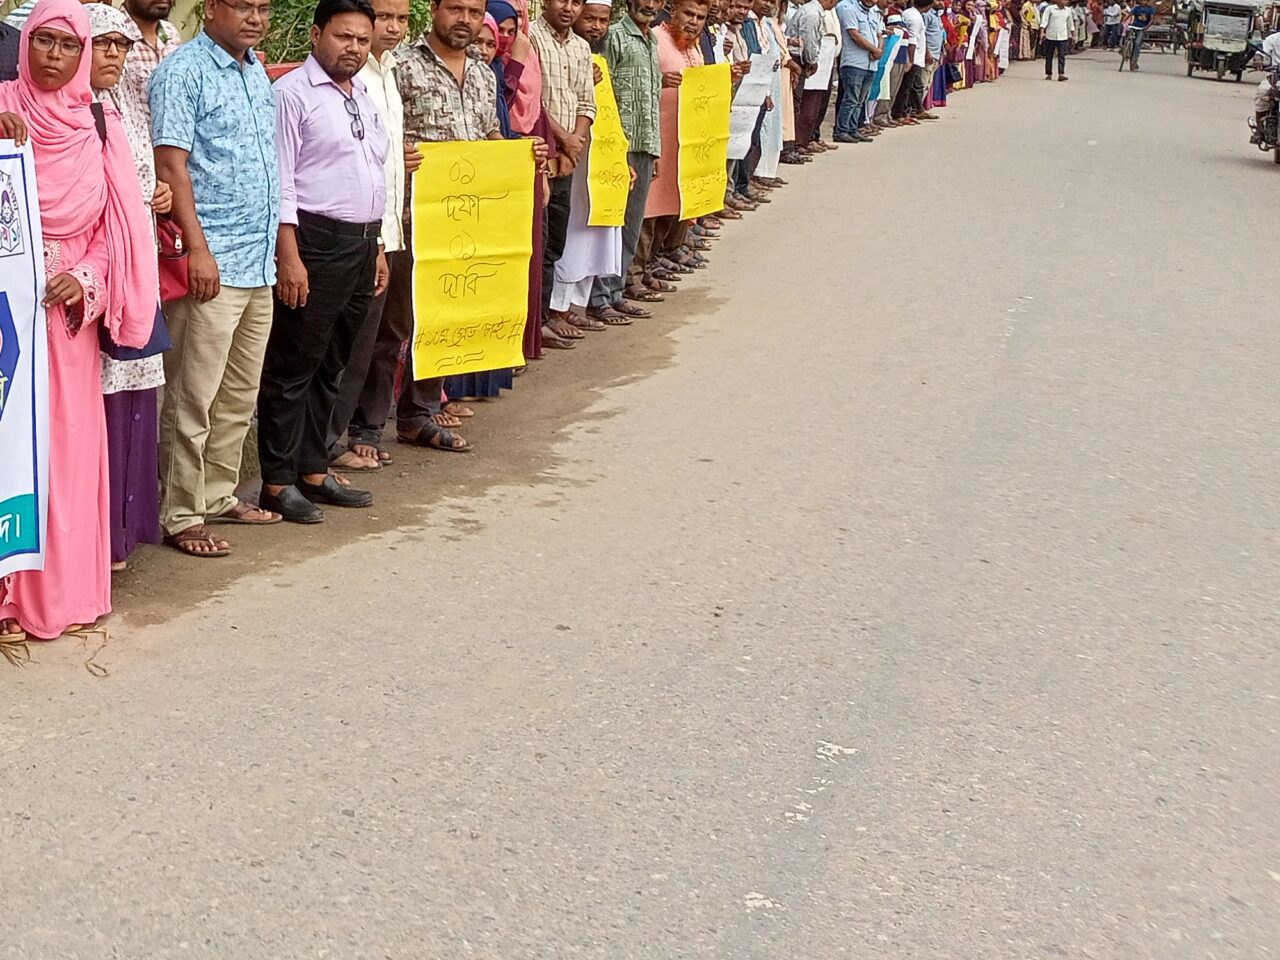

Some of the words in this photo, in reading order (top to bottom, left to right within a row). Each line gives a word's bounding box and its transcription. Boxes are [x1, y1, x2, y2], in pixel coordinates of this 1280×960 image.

[449, 155, 476, 185] ০১
[440, 190, 509, 224] দফা
[449, 230, 476, 260] ০১
[438, 262, 506, 299] দাবি
